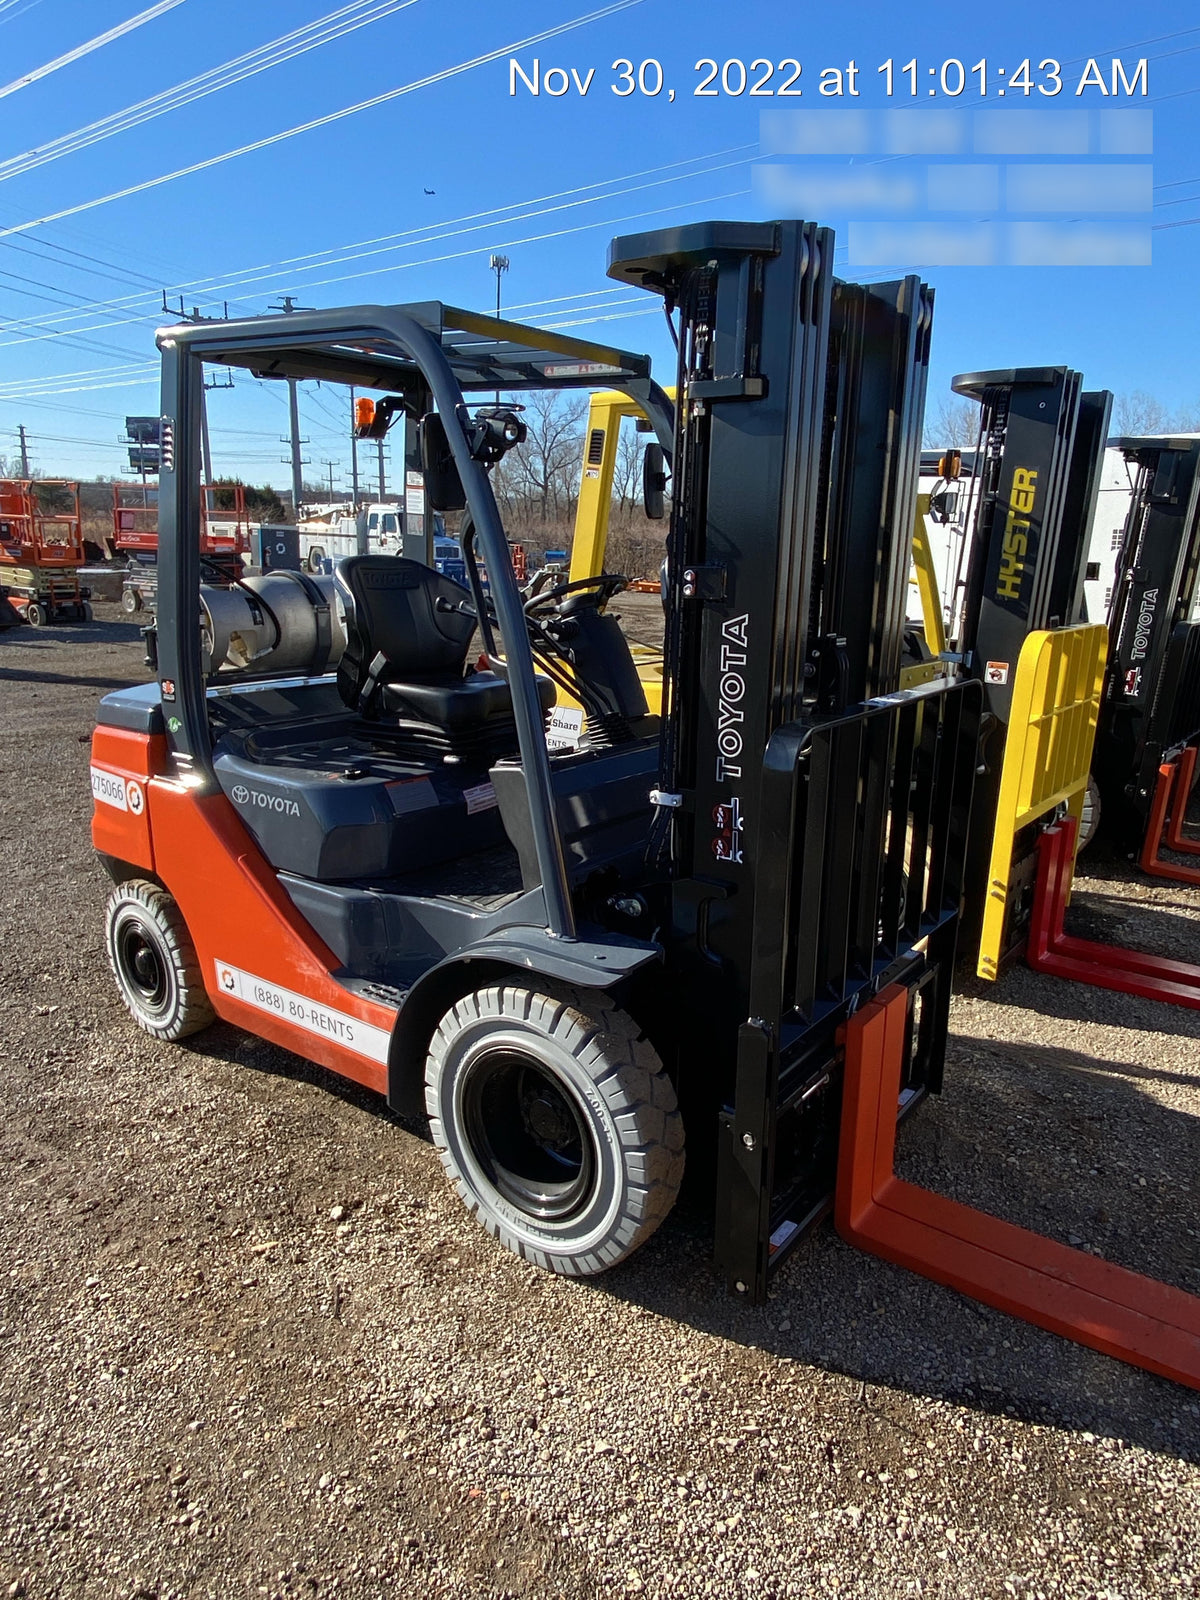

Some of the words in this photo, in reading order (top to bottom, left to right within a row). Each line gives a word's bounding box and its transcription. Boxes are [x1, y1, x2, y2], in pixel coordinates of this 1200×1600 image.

[996, 467, 1038, 599] HYSTER
[1131, 588, 1159, 660] TOYOTA
[551, 718, 578, 731] Share
[716, 614, 749, 782] TOYOTA
[91, 774, 123, 801] 275066
[251, 791, 300, 817] TOYOTA
[254, 985, 284, 1013] (888)
[289, 1001, 354, 1041] 80-RENTS
